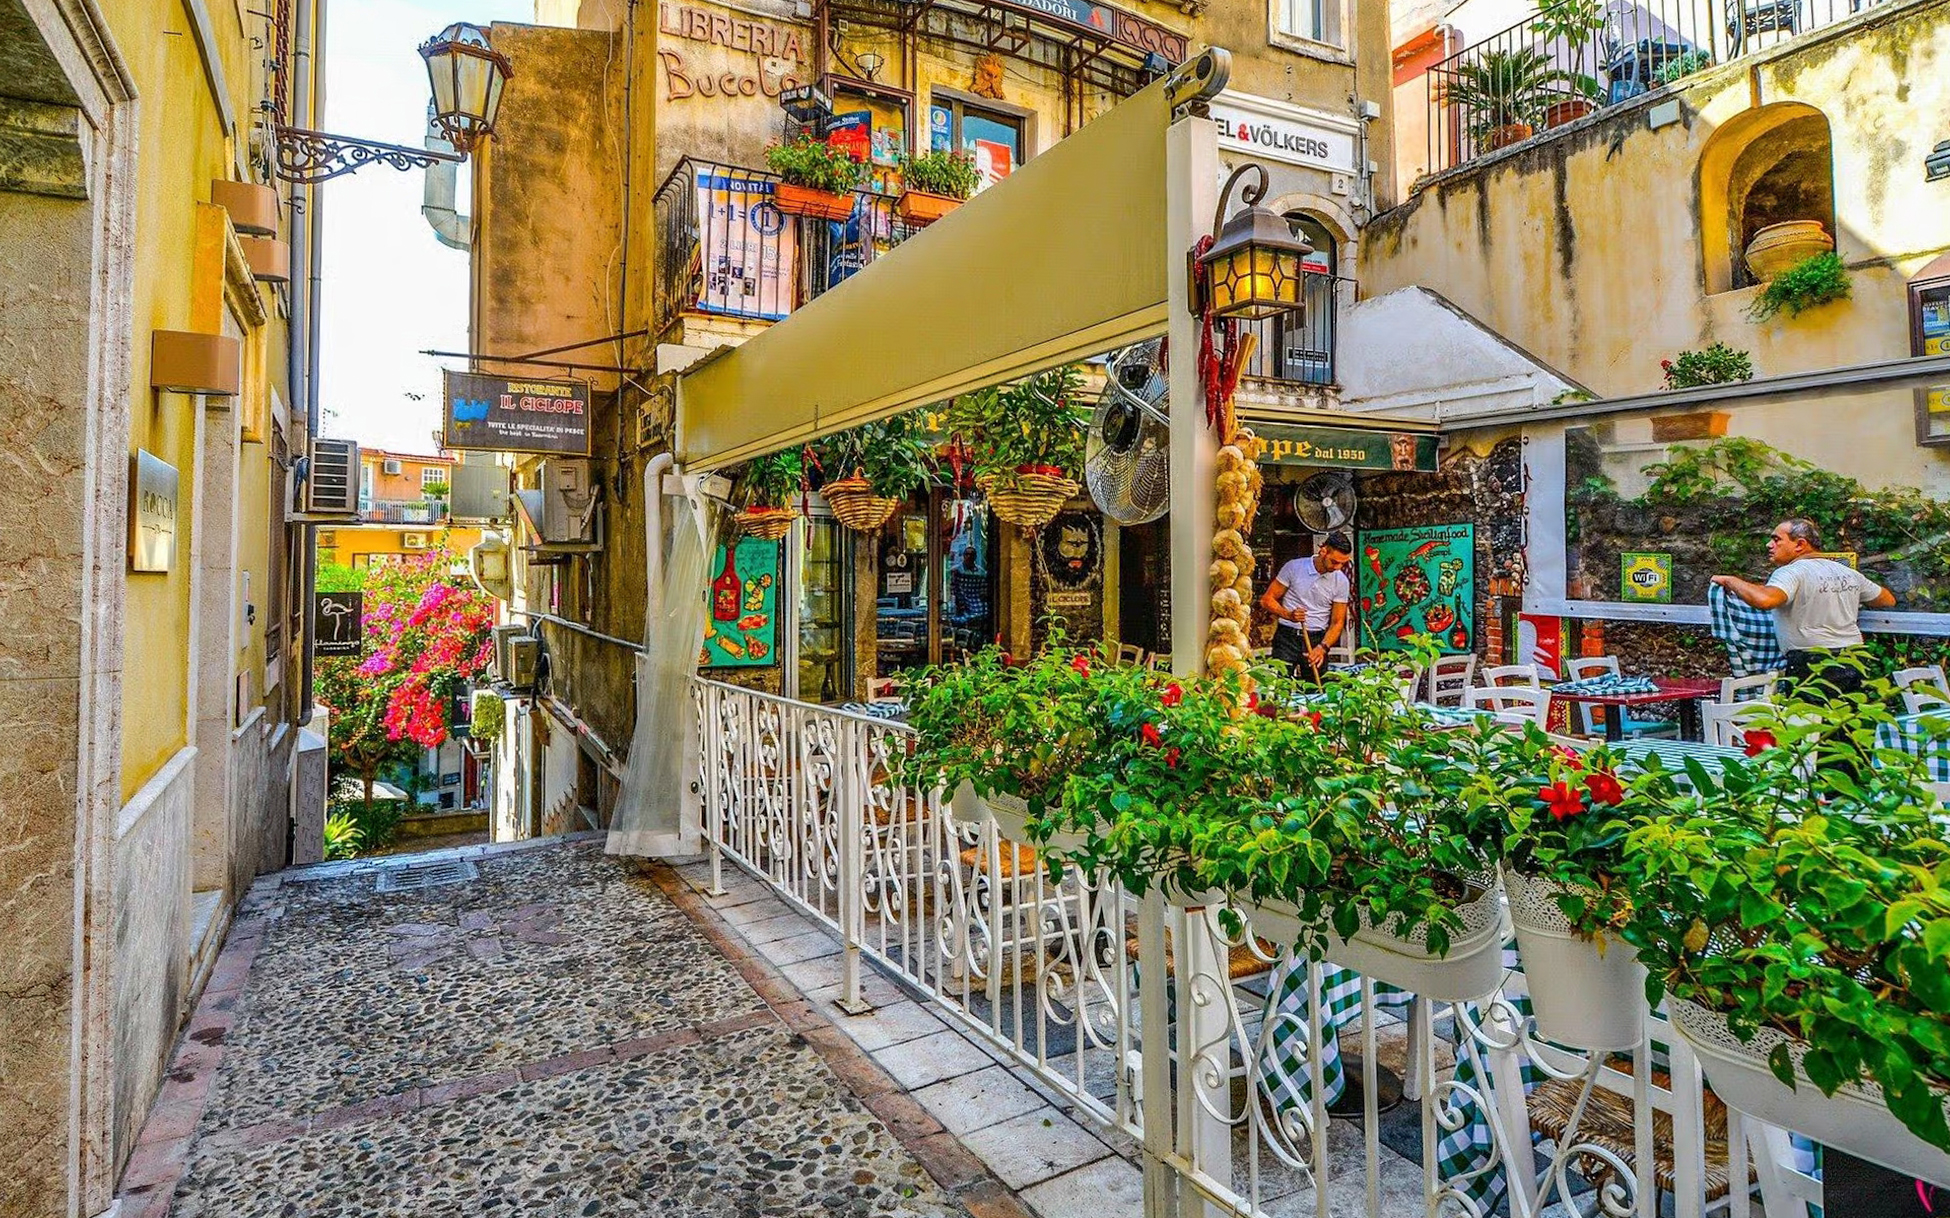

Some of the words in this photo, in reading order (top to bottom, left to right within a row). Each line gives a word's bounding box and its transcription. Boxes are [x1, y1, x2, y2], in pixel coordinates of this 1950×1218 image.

[659, 2, 805, 64] LIBRERIA
[1337, 179, 1344, 189] 2
[507, 382, 572, 398] RISTORANTE
[500, 394, 516, 410] IL
[520, 396, 584, 415] CICLOPE
[565, 427, 585, 436] PESCE
[1314, 446, 1334, 460] dal
[1337, 448, 1366, 461] 1950
